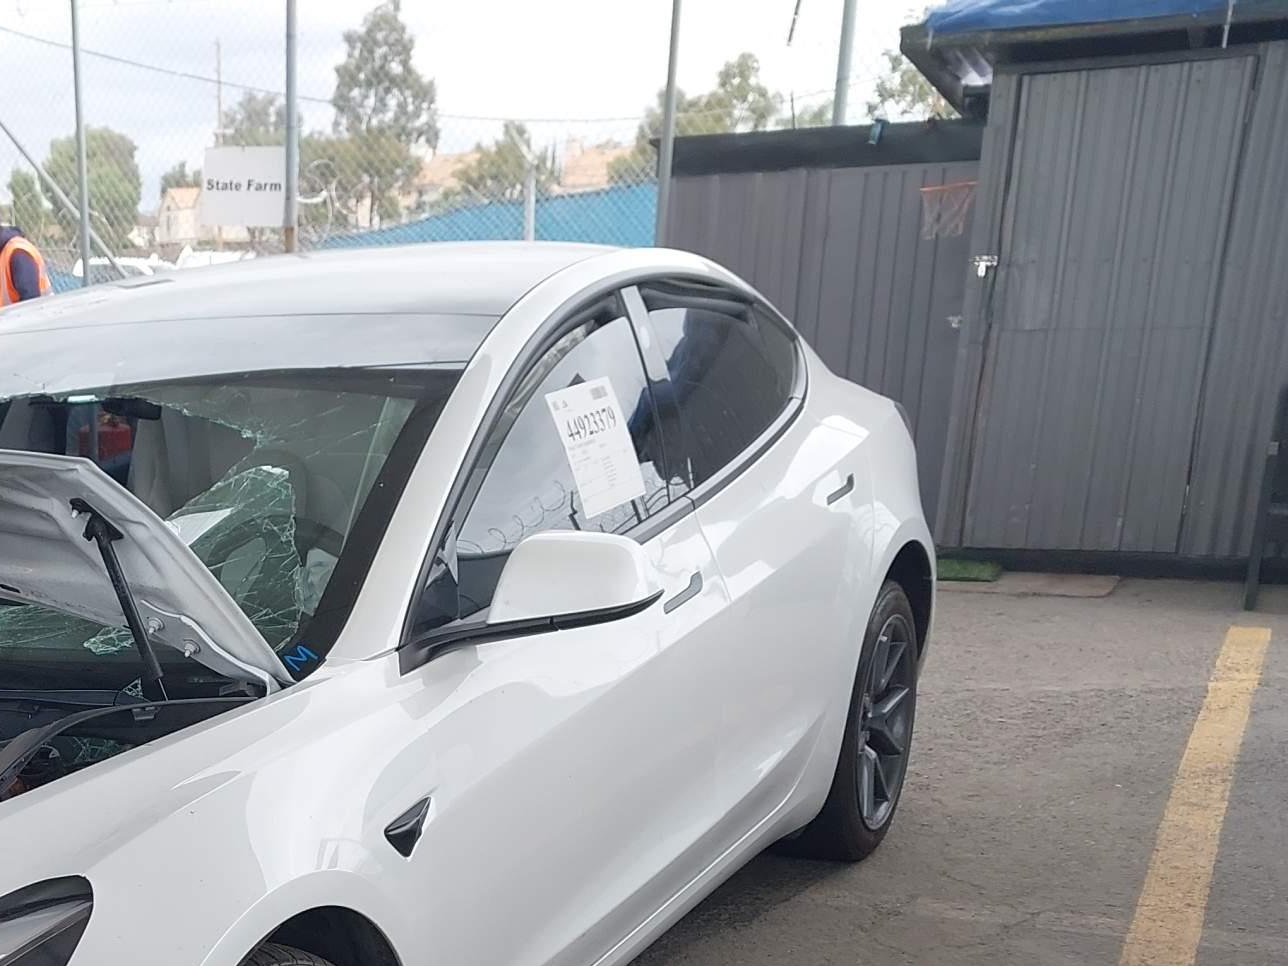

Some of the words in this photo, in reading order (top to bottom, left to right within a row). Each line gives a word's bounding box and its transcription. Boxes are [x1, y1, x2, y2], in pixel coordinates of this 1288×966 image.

[206, 178, 242, 191] State
[247, 178, 282, 191] Farm
[567, 405, 617, 441] 44923379
[283, 645, 319, 672] M
